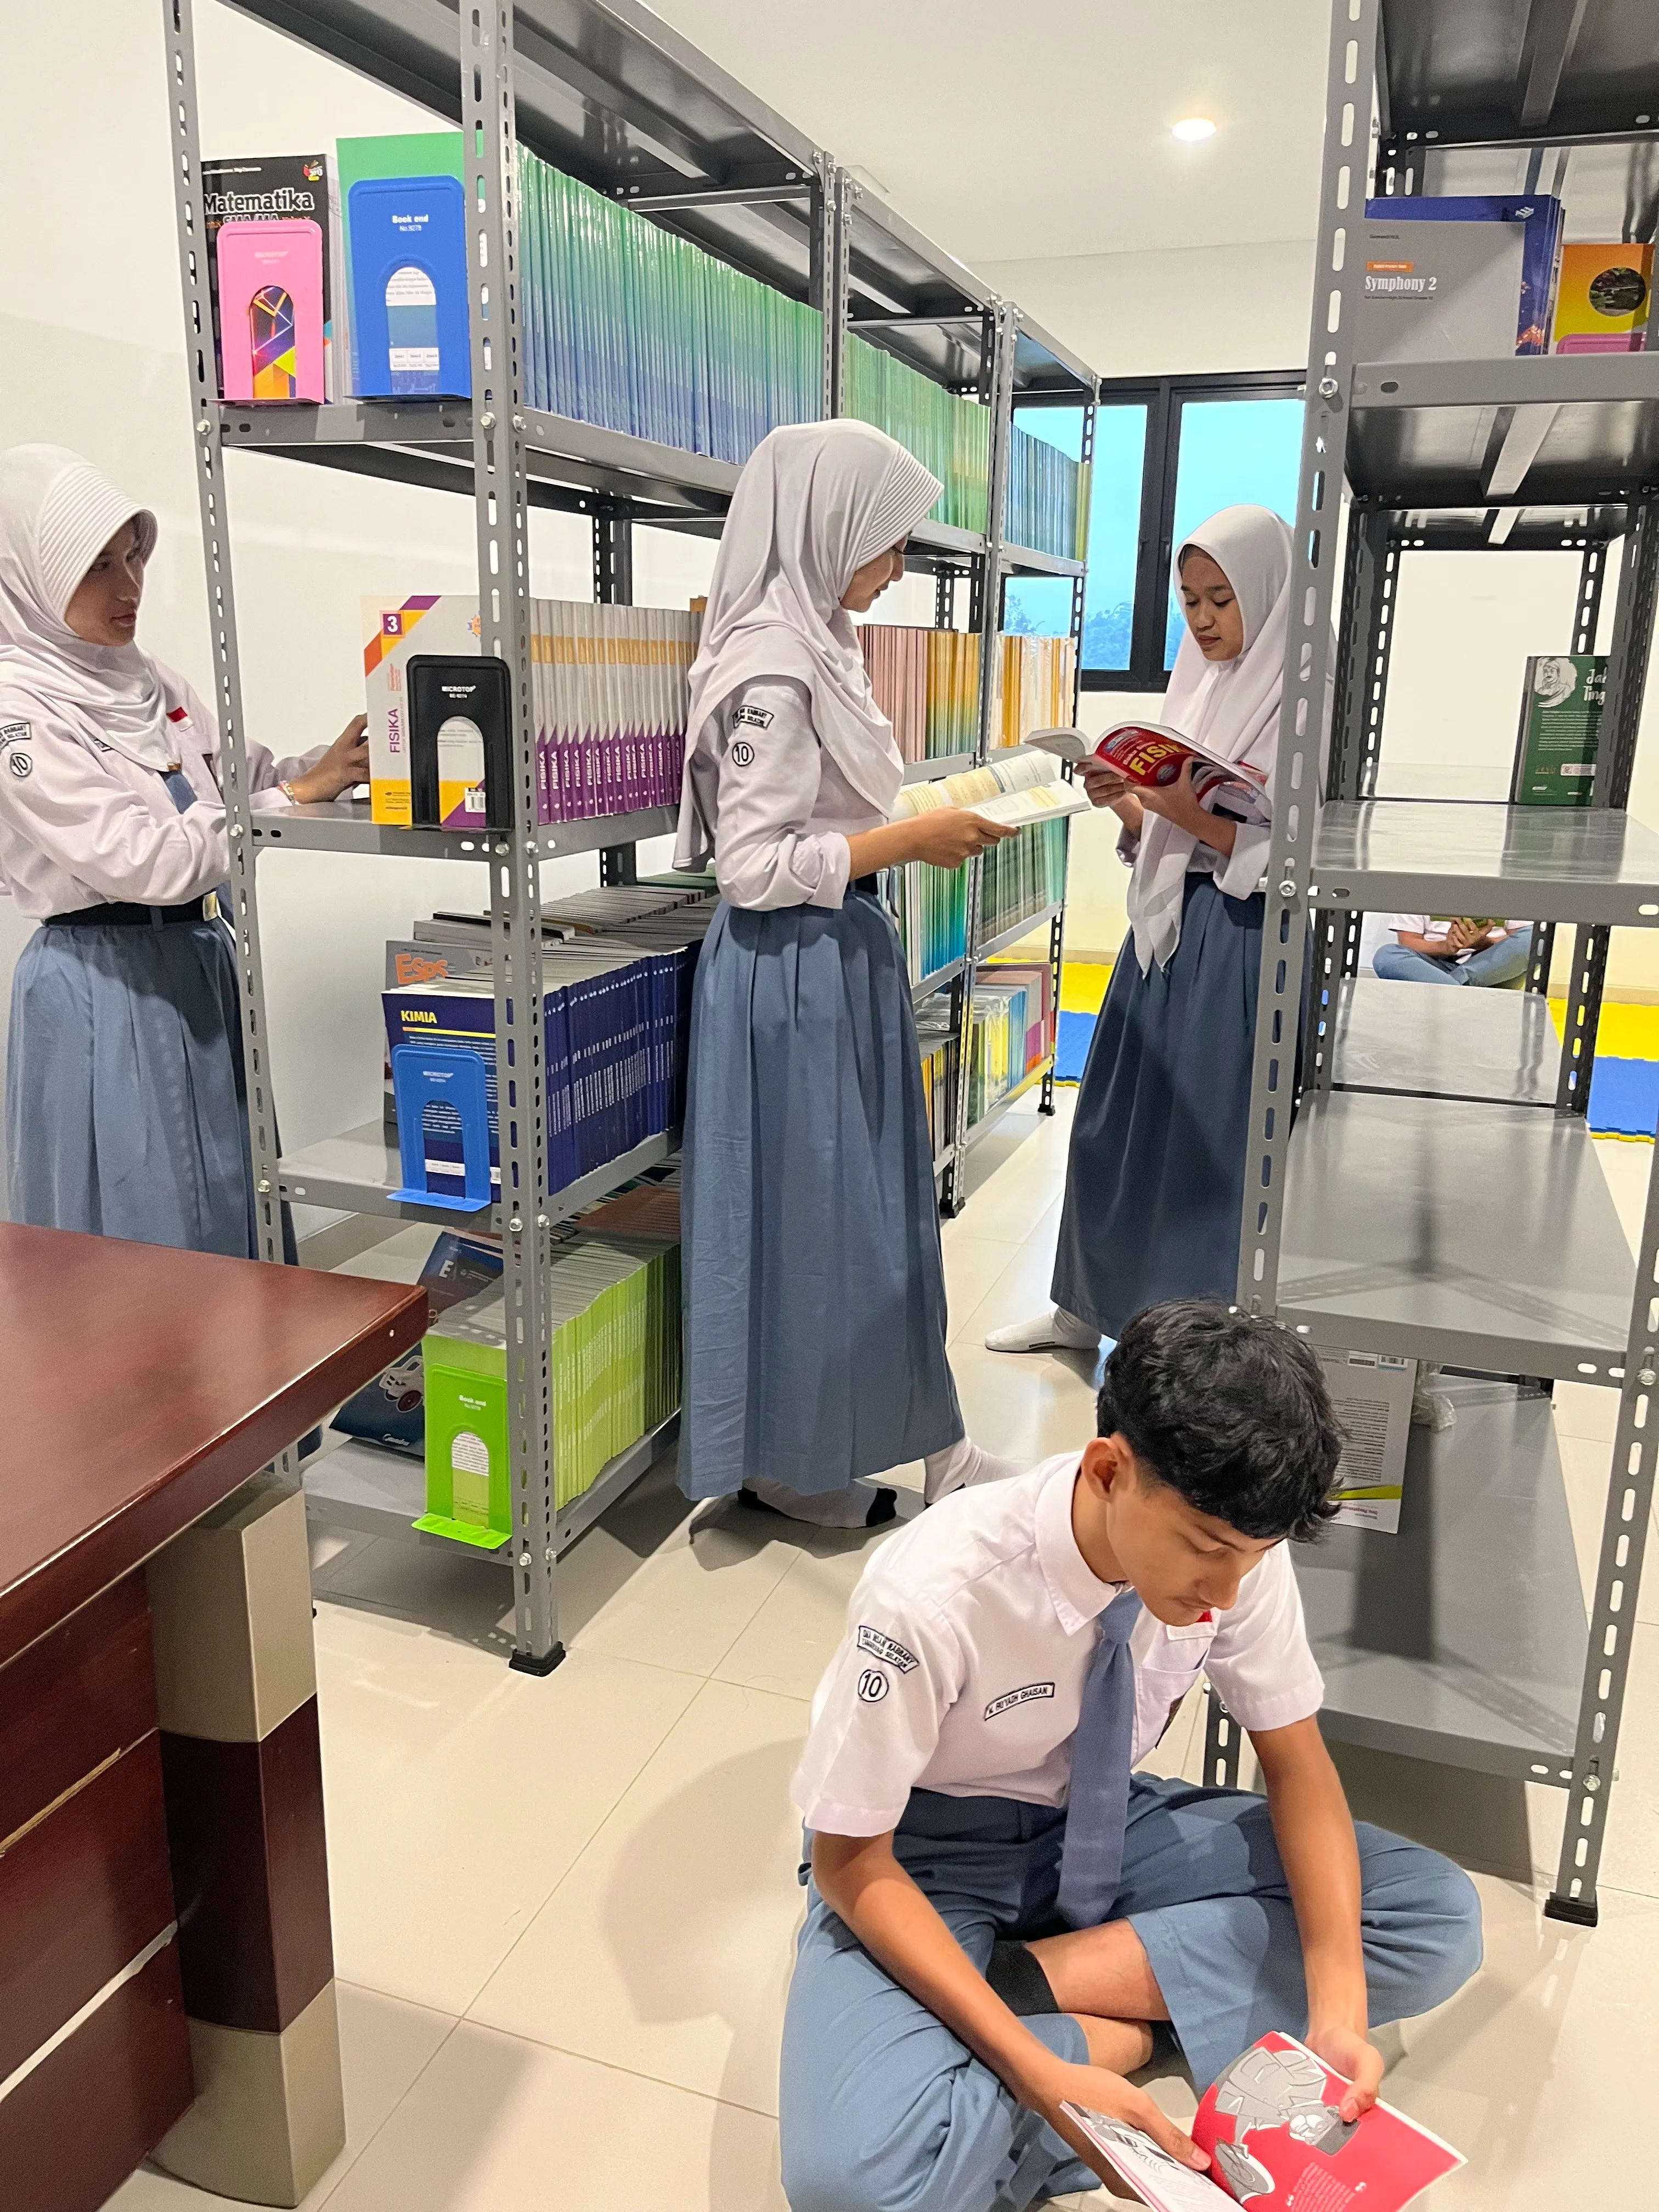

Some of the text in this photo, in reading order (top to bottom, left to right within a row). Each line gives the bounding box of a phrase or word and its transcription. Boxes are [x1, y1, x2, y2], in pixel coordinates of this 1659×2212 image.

[204, 188, 315, 215] Matematika
[392, 215, 412, 223] Book
[1365, 275, 1437, 292] Symphony 2
[387, 616, 398, 633] 3
[387, 708, 400, 753] FISIKA
[735, 746, 749, 762] 10
[12, 756, 29, 774] 10
[551, 751, 559, 789] FISIKA
[400, 1010, 438, 1024] KIMIA
[861, 1673, 882, 1697] 10
